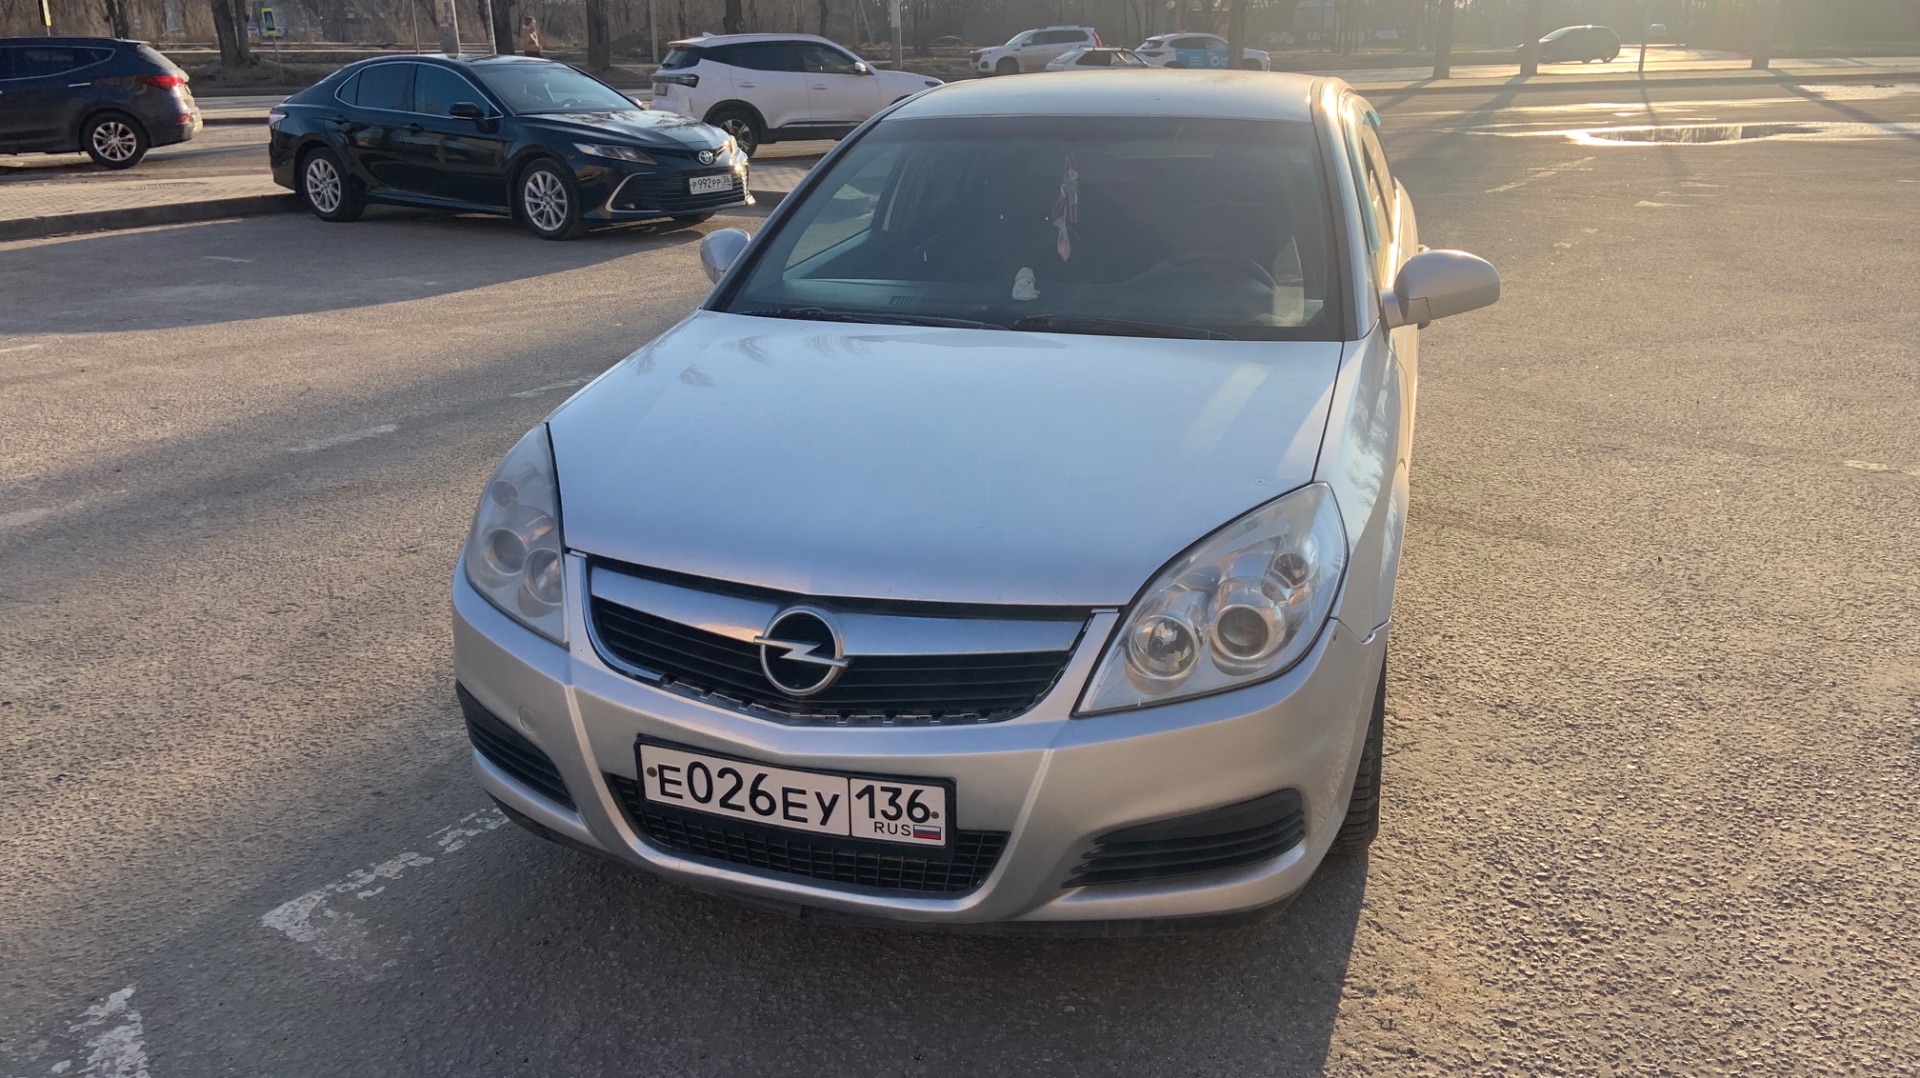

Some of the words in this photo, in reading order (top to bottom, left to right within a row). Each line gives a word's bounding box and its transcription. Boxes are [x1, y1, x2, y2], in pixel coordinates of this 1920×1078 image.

[657, 761, 840, 826] Е026ЕУ
[855, 784, 931, 824] 136
[874, 821, 912, 837] RUS
